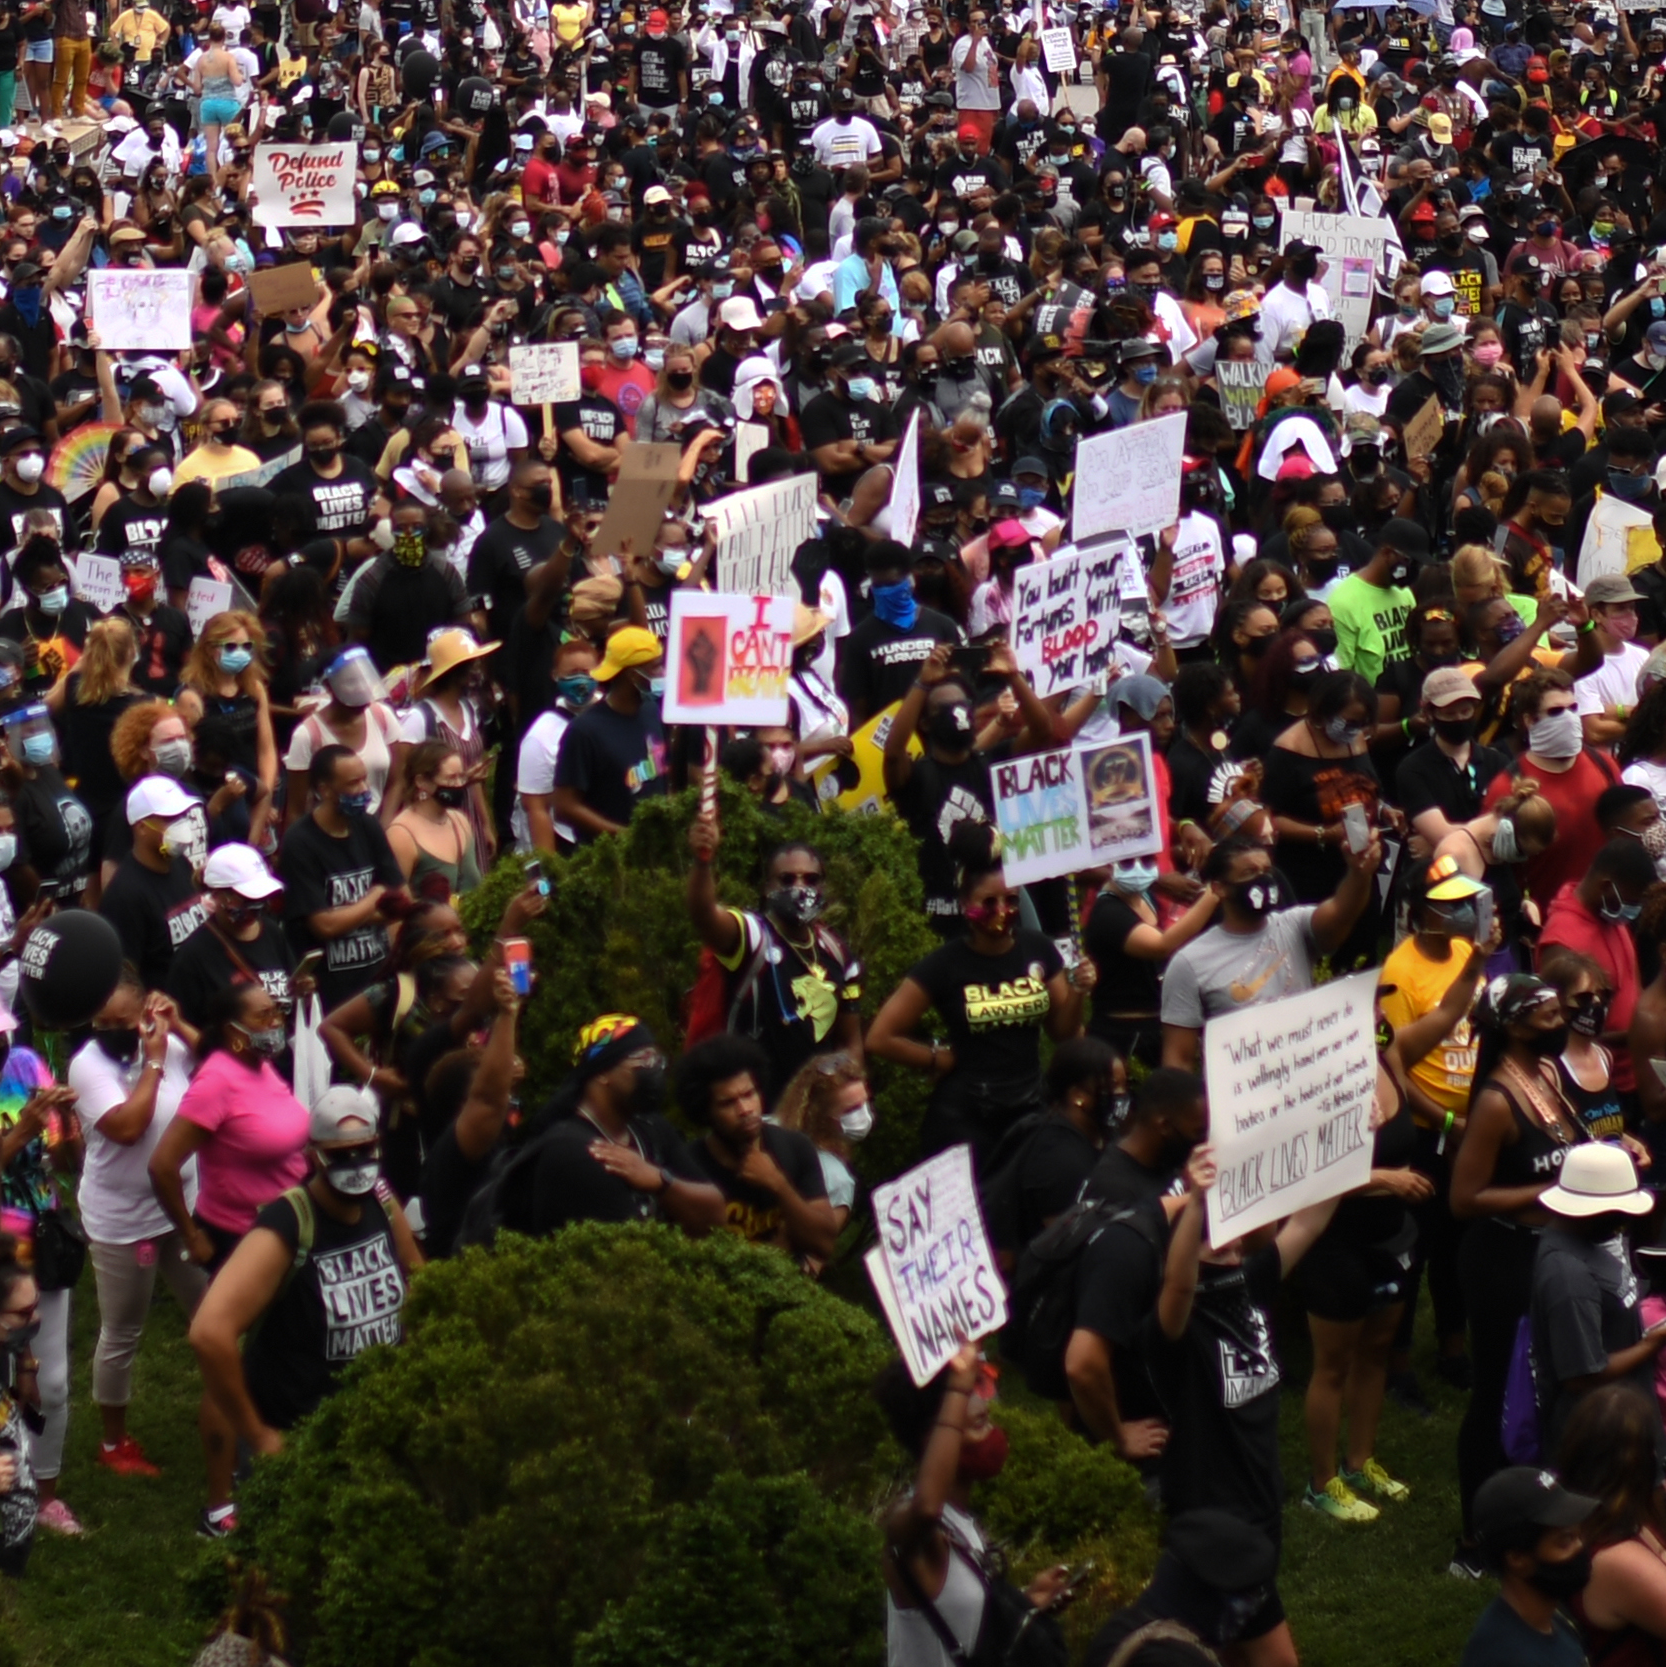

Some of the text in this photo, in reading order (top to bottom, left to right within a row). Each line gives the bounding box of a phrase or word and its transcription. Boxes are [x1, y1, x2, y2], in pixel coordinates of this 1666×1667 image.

[267, 150, 344, 174] Defund
[277, 172, 337, 193] Police
[1302, 213, 1347, 234] FUCK
[313, 482, 364, 502] BLACK
[320, 495, 363, 514] LIVES
[86, 561, 113, 583] The
[749, 595, 773, 631] I
[883, 638, 935, 655] UNDER
[1041, 619, 1099, 666] BLOOD
[996, 752, 1075, 801] BLACK
[999, 783, 1080, 834] LIVES
[1001, 815, 1083, 866] MATTER
[963, 977, 1045, 1002] BLACK
[966, 996, 1051, 1020] LAWYERS
[1267, 1035, 1285, 1053] we
[1288, 1020, 1314, 1046] must
[1317, 1010, 1340, 1033] never
[1234, 1081, 1243, 1097] is
[1247, 1058, 1291, 1091] willingly
[1235, 1108, 1266, 1134] bodies
[1283, 1093, 1297, 1110] the
[1219, 1103, 1364, 1218] BLACK LIVES MATTER
[886, 1176, 933, 1255] SAY
[319, 1236, 391, 1282] BLACK
[899, 1218, 979, 1304] THEIR
[327, 1271, 402, 1323] LIVES
[909, 1264, 996, 1371] NAMES
[332, 1312, 400, 1357] MATTER
